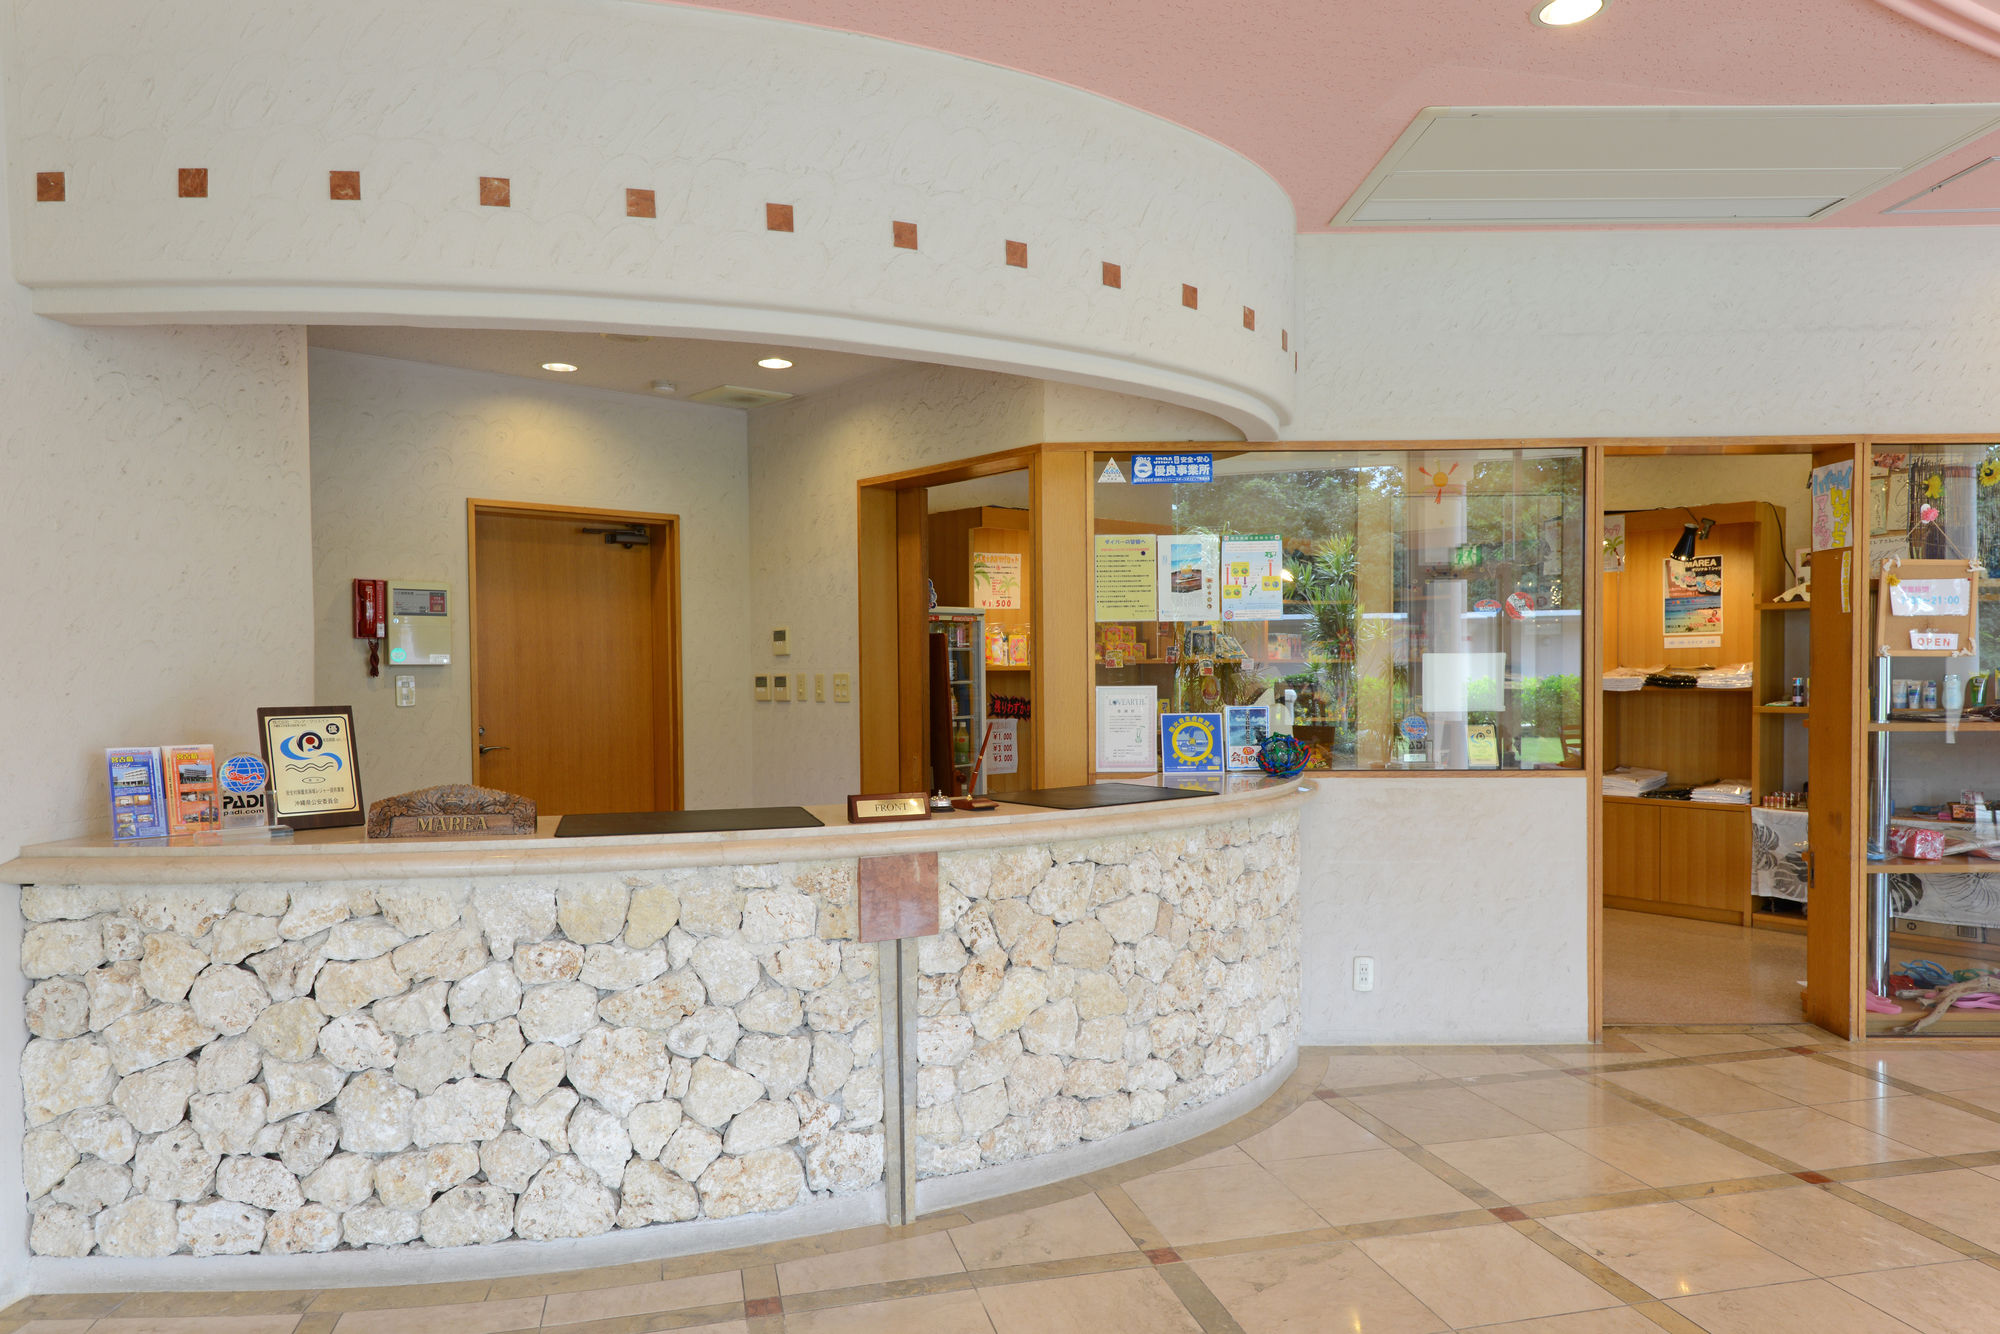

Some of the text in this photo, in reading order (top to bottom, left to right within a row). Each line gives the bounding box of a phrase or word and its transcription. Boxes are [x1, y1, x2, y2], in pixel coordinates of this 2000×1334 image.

[1154, 464, 1211, 477] 優良事業所
[1684, 558, 1717, 567] MAREA
[1917, 637, 1951, 647] OPEN
[223, 794, 264, 809] PADI
[874, 802, 907, 812] FRONT
[416, 816, 489, 832] MAREA
